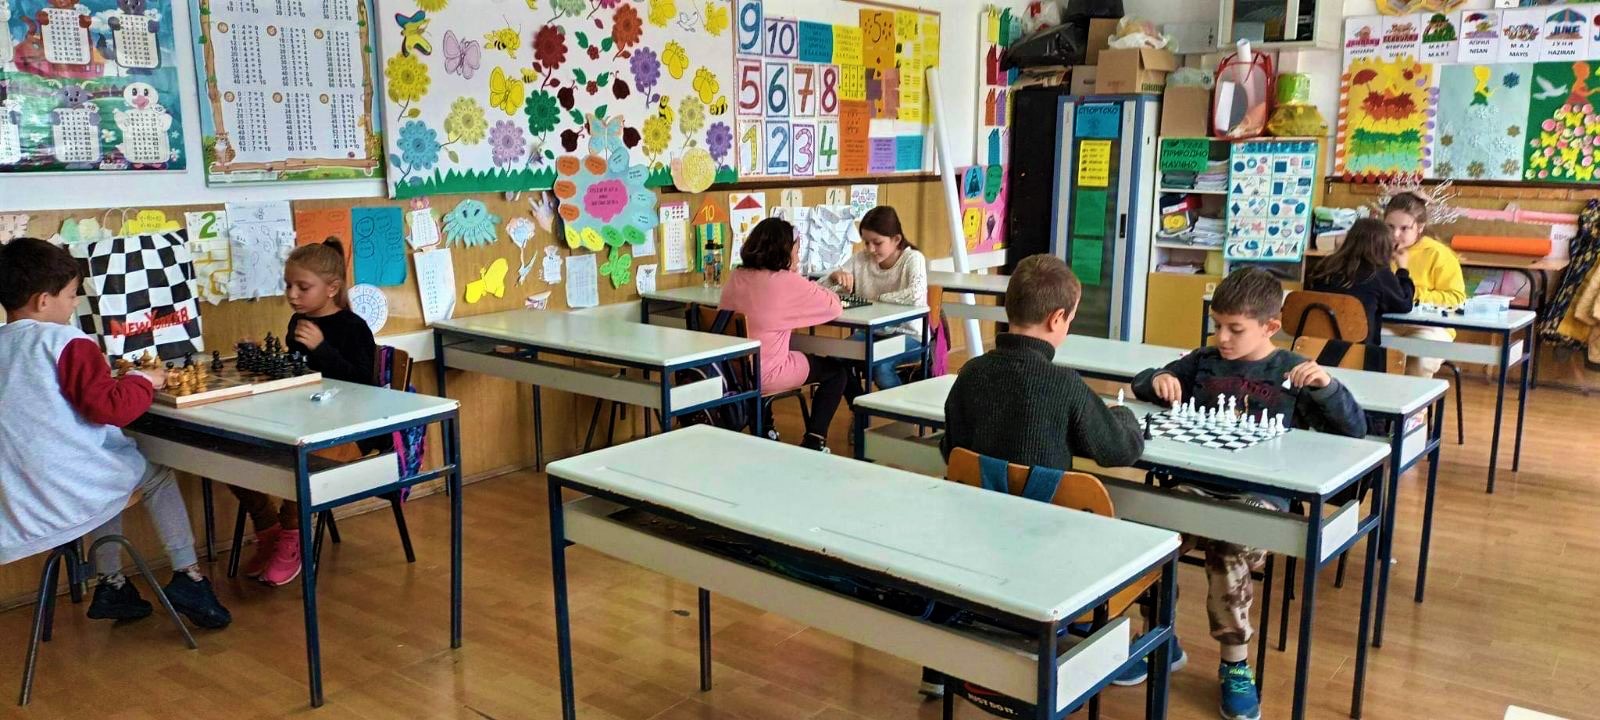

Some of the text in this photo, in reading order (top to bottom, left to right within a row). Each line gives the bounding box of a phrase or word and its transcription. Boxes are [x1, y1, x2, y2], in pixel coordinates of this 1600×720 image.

[739, 2, 761, 50] 9
[767, 23, 796, 55] 10
[872, 13, 882, 43] 5
[739, 66, 761, 110] 5
[768, 67, 787, 113] 6
[794, 67, 814, 113] 7
[821, 68, 838, 113] 8
[742, 125, 757, 172] 1
[768, 126, 788, 168] 2
[794, 129, 813, 173] 3
[820, 125, 838, 167] 4
[199, 212, 217, 239] 2
[664, 210, 670, 219] 9
[701, 204, 715, 221] 10
